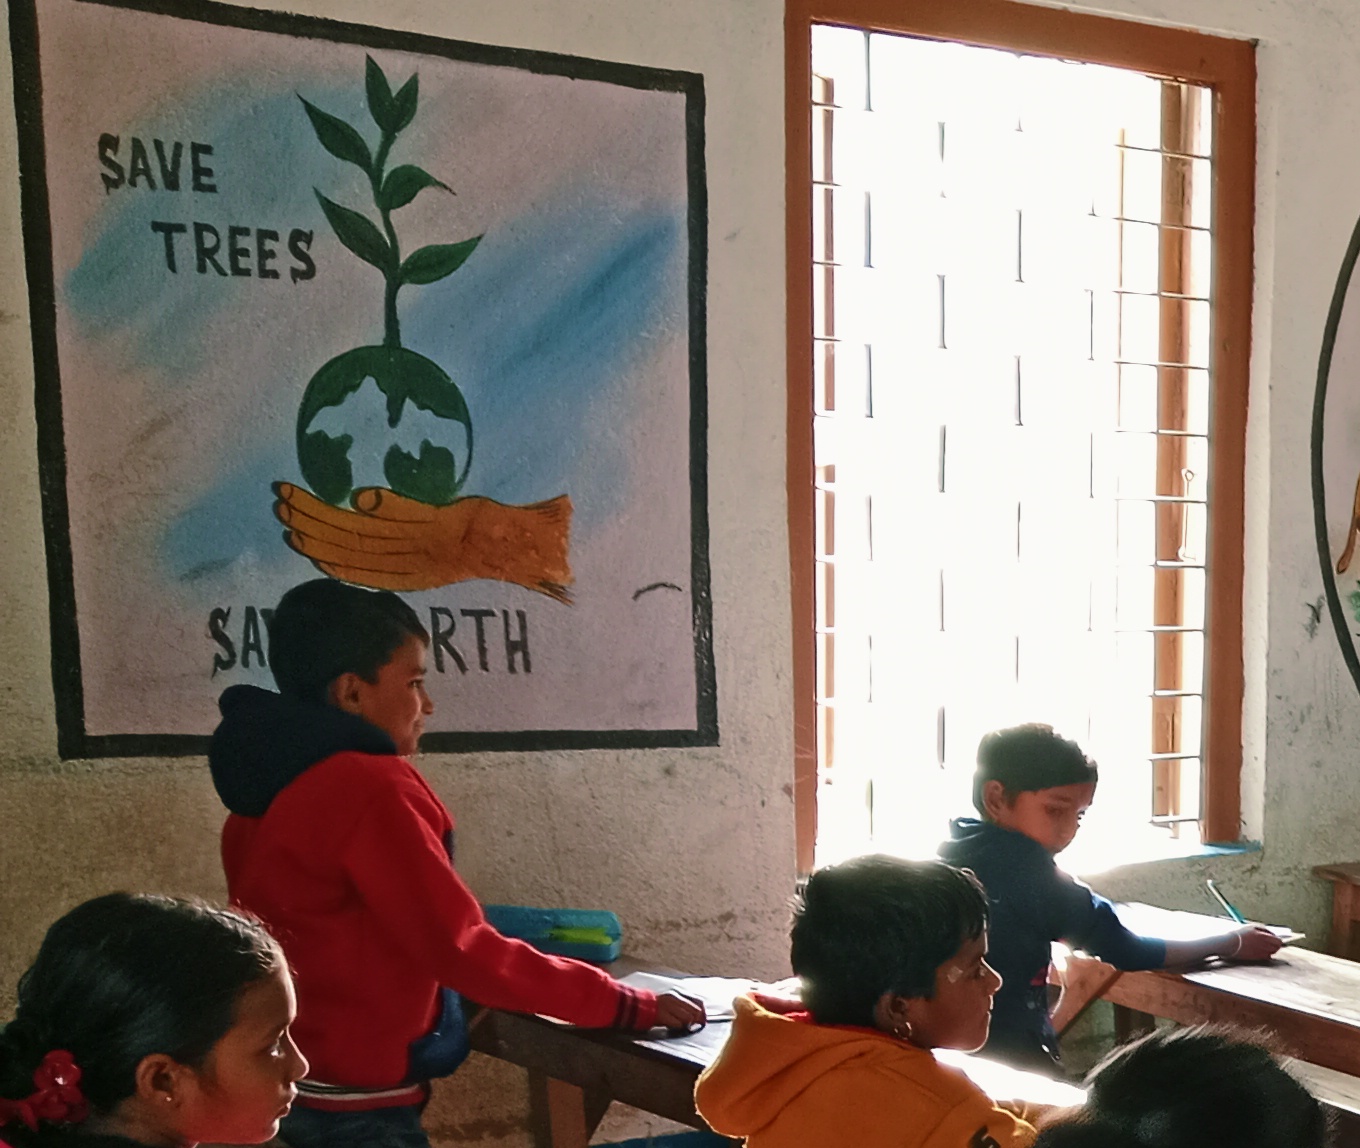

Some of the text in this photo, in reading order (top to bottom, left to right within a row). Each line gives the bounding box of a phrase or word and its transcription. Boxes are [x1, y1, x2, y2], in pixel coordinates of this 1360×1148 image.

[98, 131, 219, 194] SAVE
[151, 219, 318, 282] TREES
[208, 604, 534, 681] SA RTH
